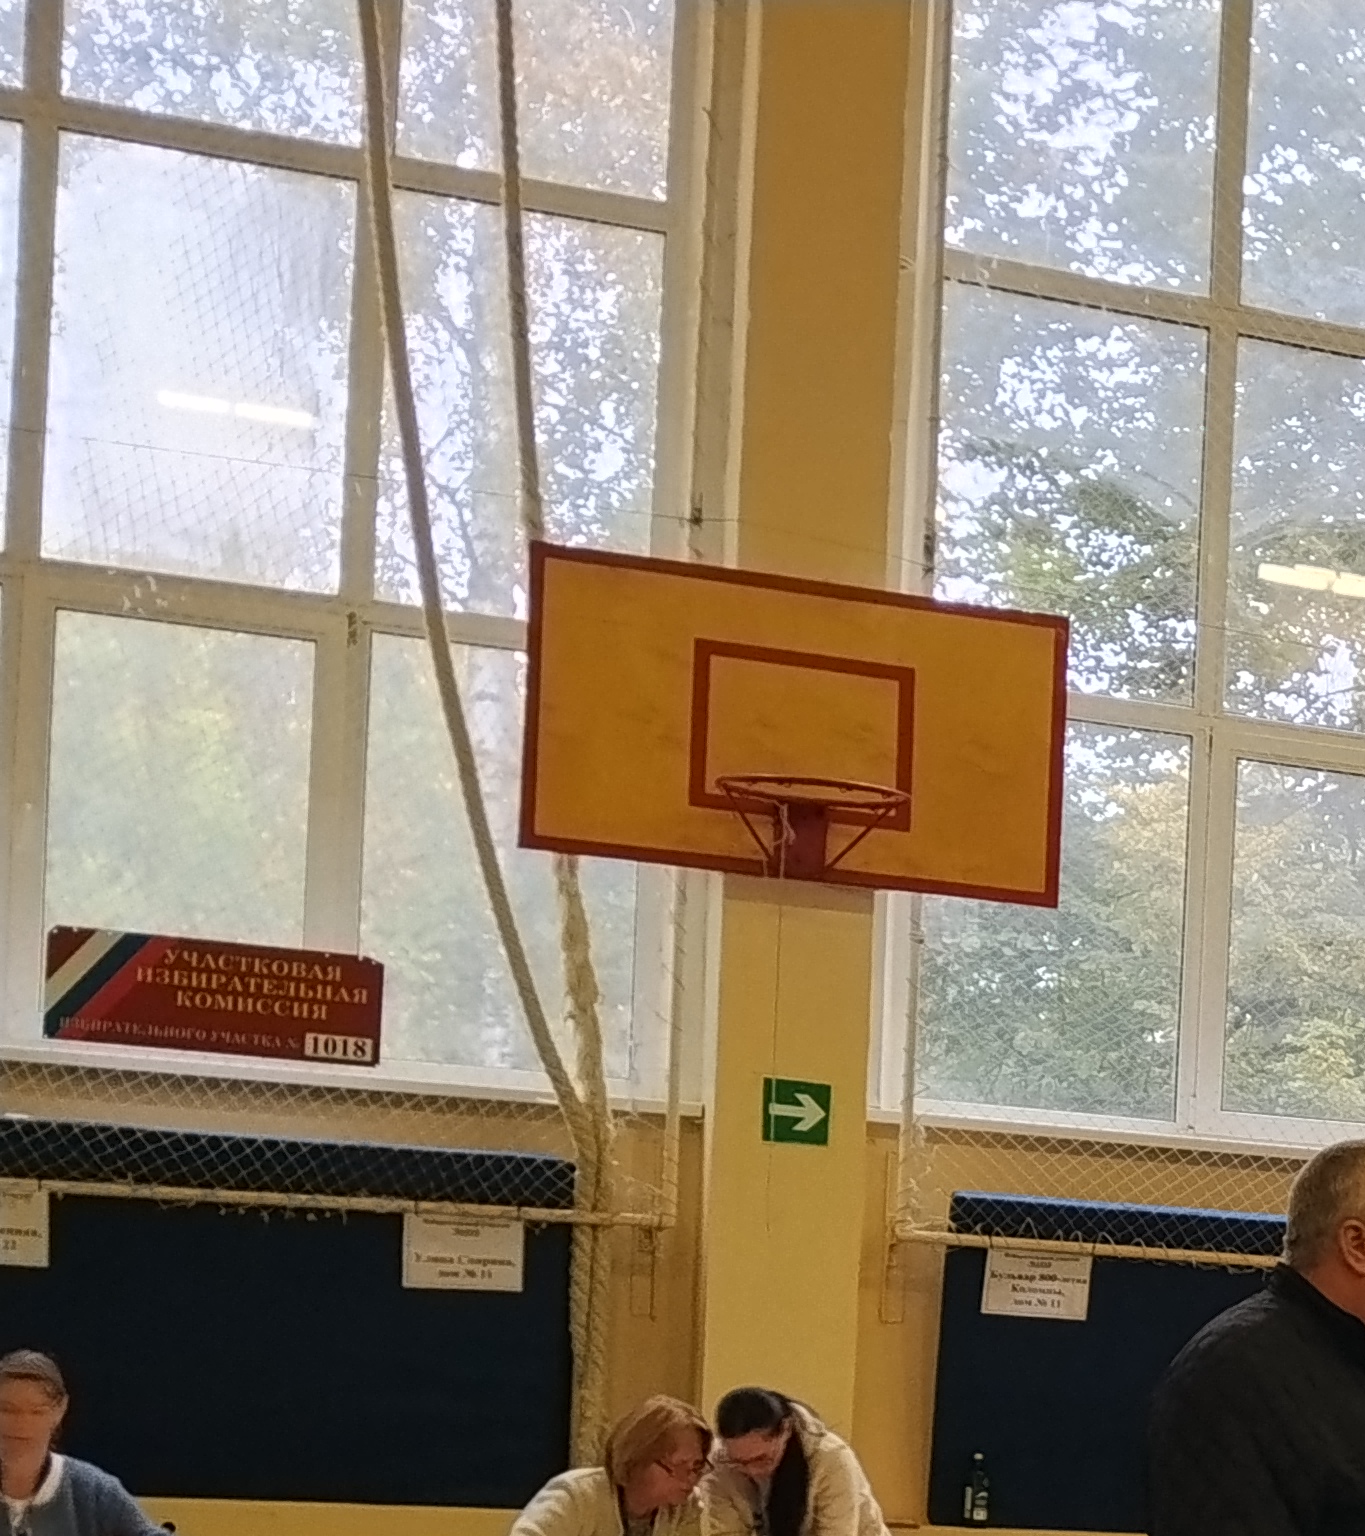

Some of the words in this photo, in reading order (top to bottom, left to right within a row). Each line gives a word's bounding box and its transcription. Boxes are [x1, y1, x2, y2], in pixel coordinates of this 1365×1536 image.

[165, 948, 343, 983] УЧАСТКОВАЯ
[136, 966, 370, 1005] ИЗБИРАТЕЛЬНАЯ
[176, 989, 329, 1021] КОМИССИЯ
[59, 1015, 207, 1042] ИЗБИРАТЕЛЬНОГО
[210, 1029, 282, 1049] УЧАСТКА
[310, 1034, 368, 1059] 1018
